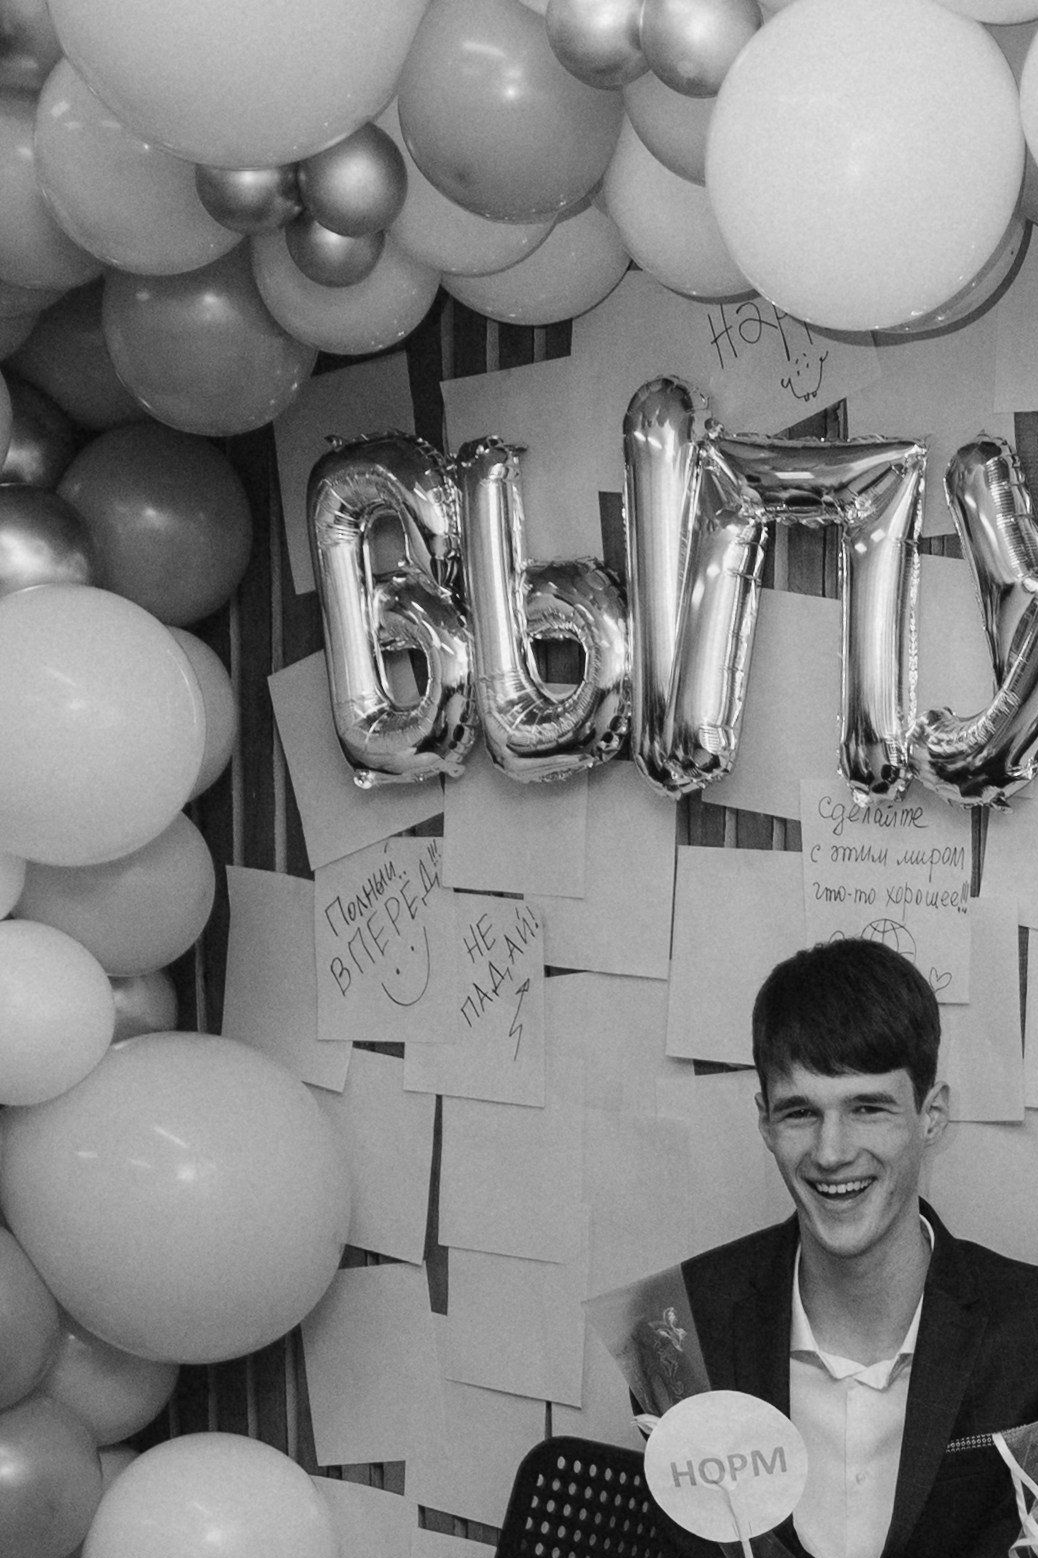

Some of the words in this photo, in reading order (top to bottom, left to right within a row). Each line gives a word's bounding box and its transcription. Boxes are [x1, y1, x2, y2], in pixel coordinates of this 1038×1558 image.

[817, 795, 929, 836] Сделайте
[830, 845, 888, 868] этим
[896, 846, 966, 884] миром
[463, 912, 497, 964] НЕ
[670, 1446, 788, 1489] НОРМ
